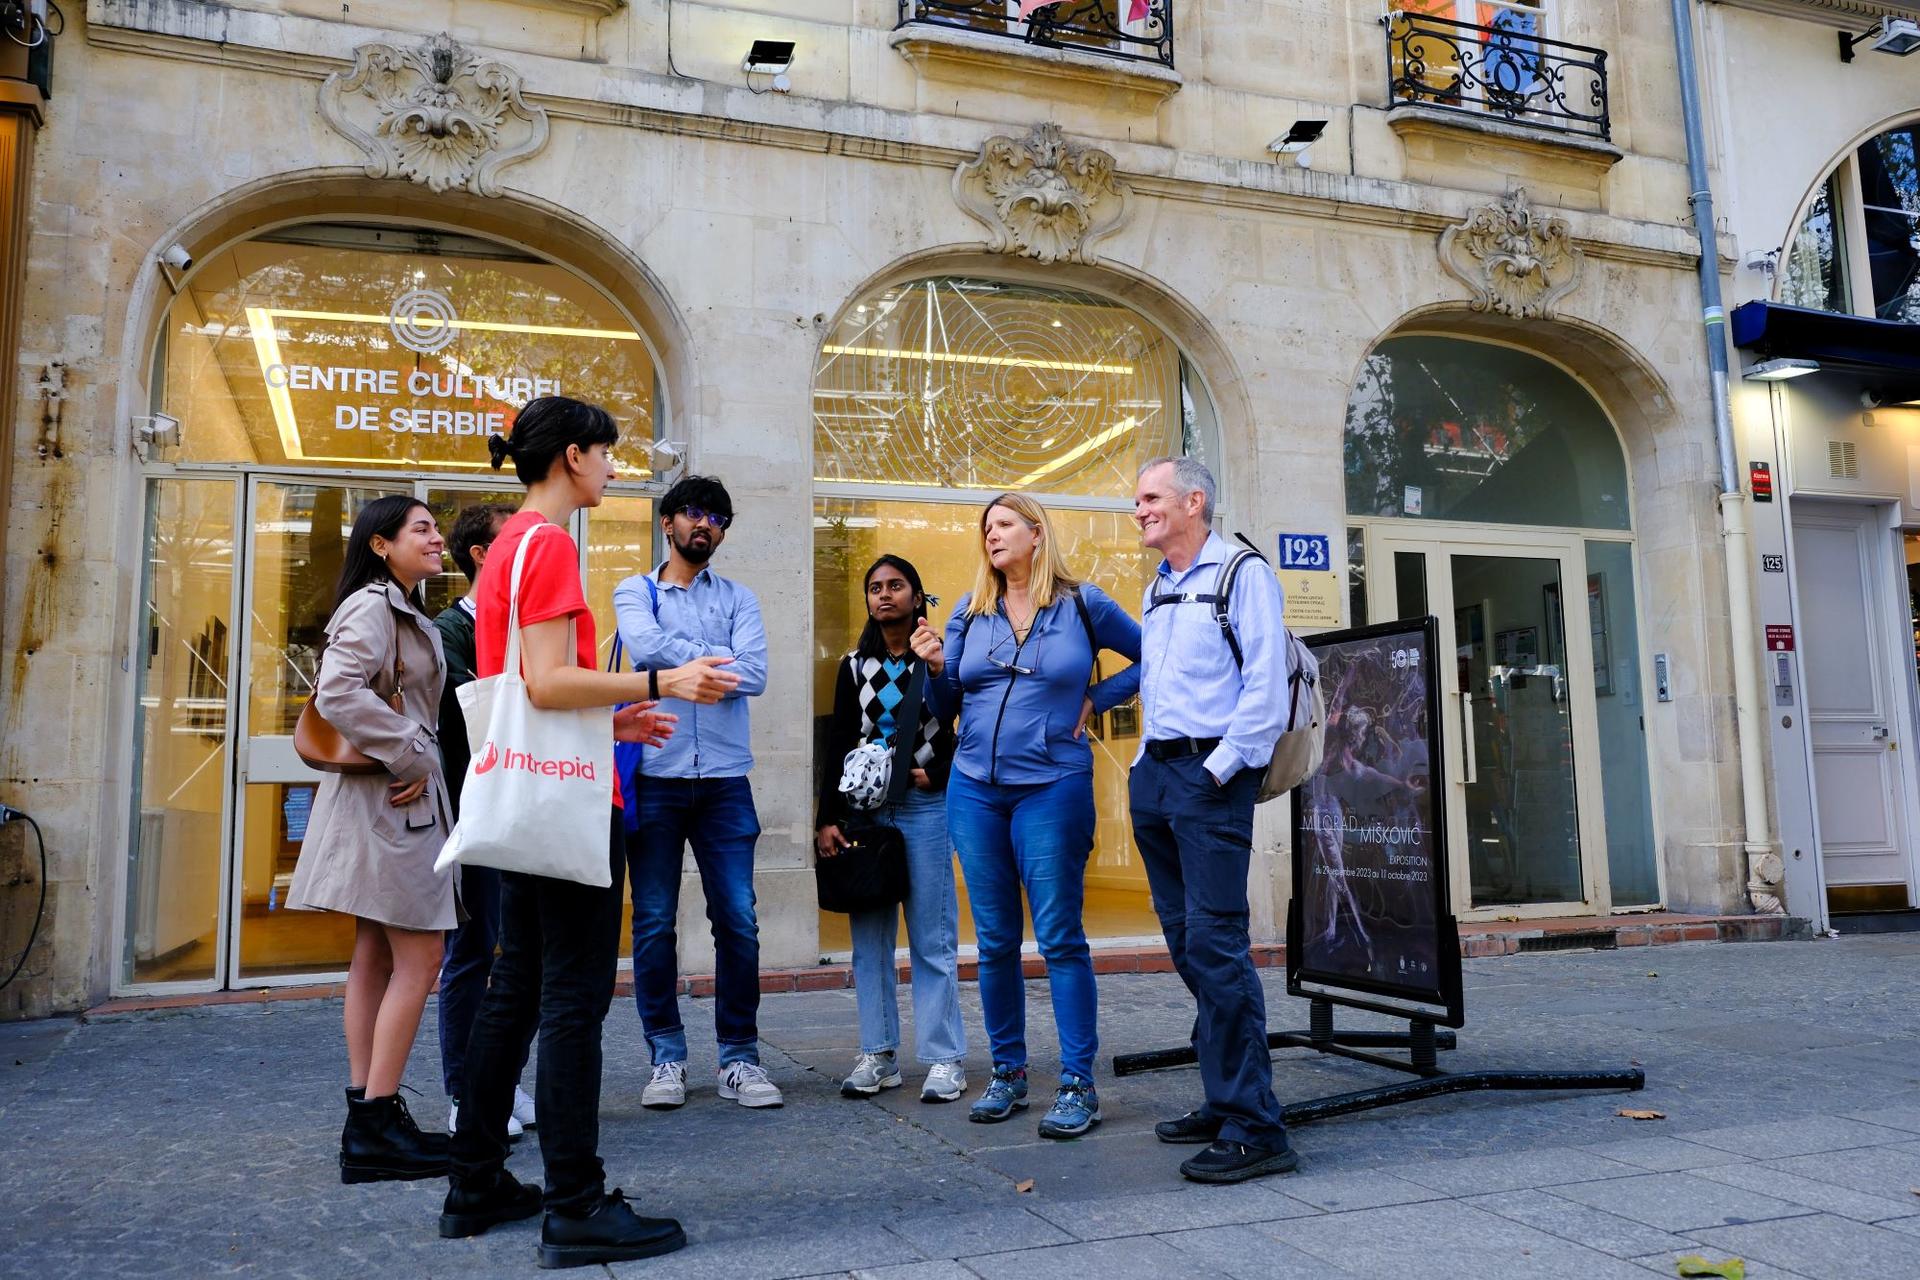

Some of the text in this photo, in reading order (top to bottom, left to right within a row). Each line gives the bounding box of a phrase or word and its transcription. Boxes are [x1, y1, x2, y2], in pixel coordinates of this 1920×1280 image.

[264, 363, 399, 394] CENTRE
[335, 405, 505, 437] DE SERBIE
[1284, 538, 1324, 566] 123
[1765, 557, 1781, 569] 125
[503, 748, 595, 782] Intrepid
[1302, 815, 1421, 845] MILORAD MIŠKOVIĆ
[1355, 867, 1372, 878] 2023
[1411, 871, 1428, 882] 2023
[1389, 855, 1428, 867] EXPOSITION
